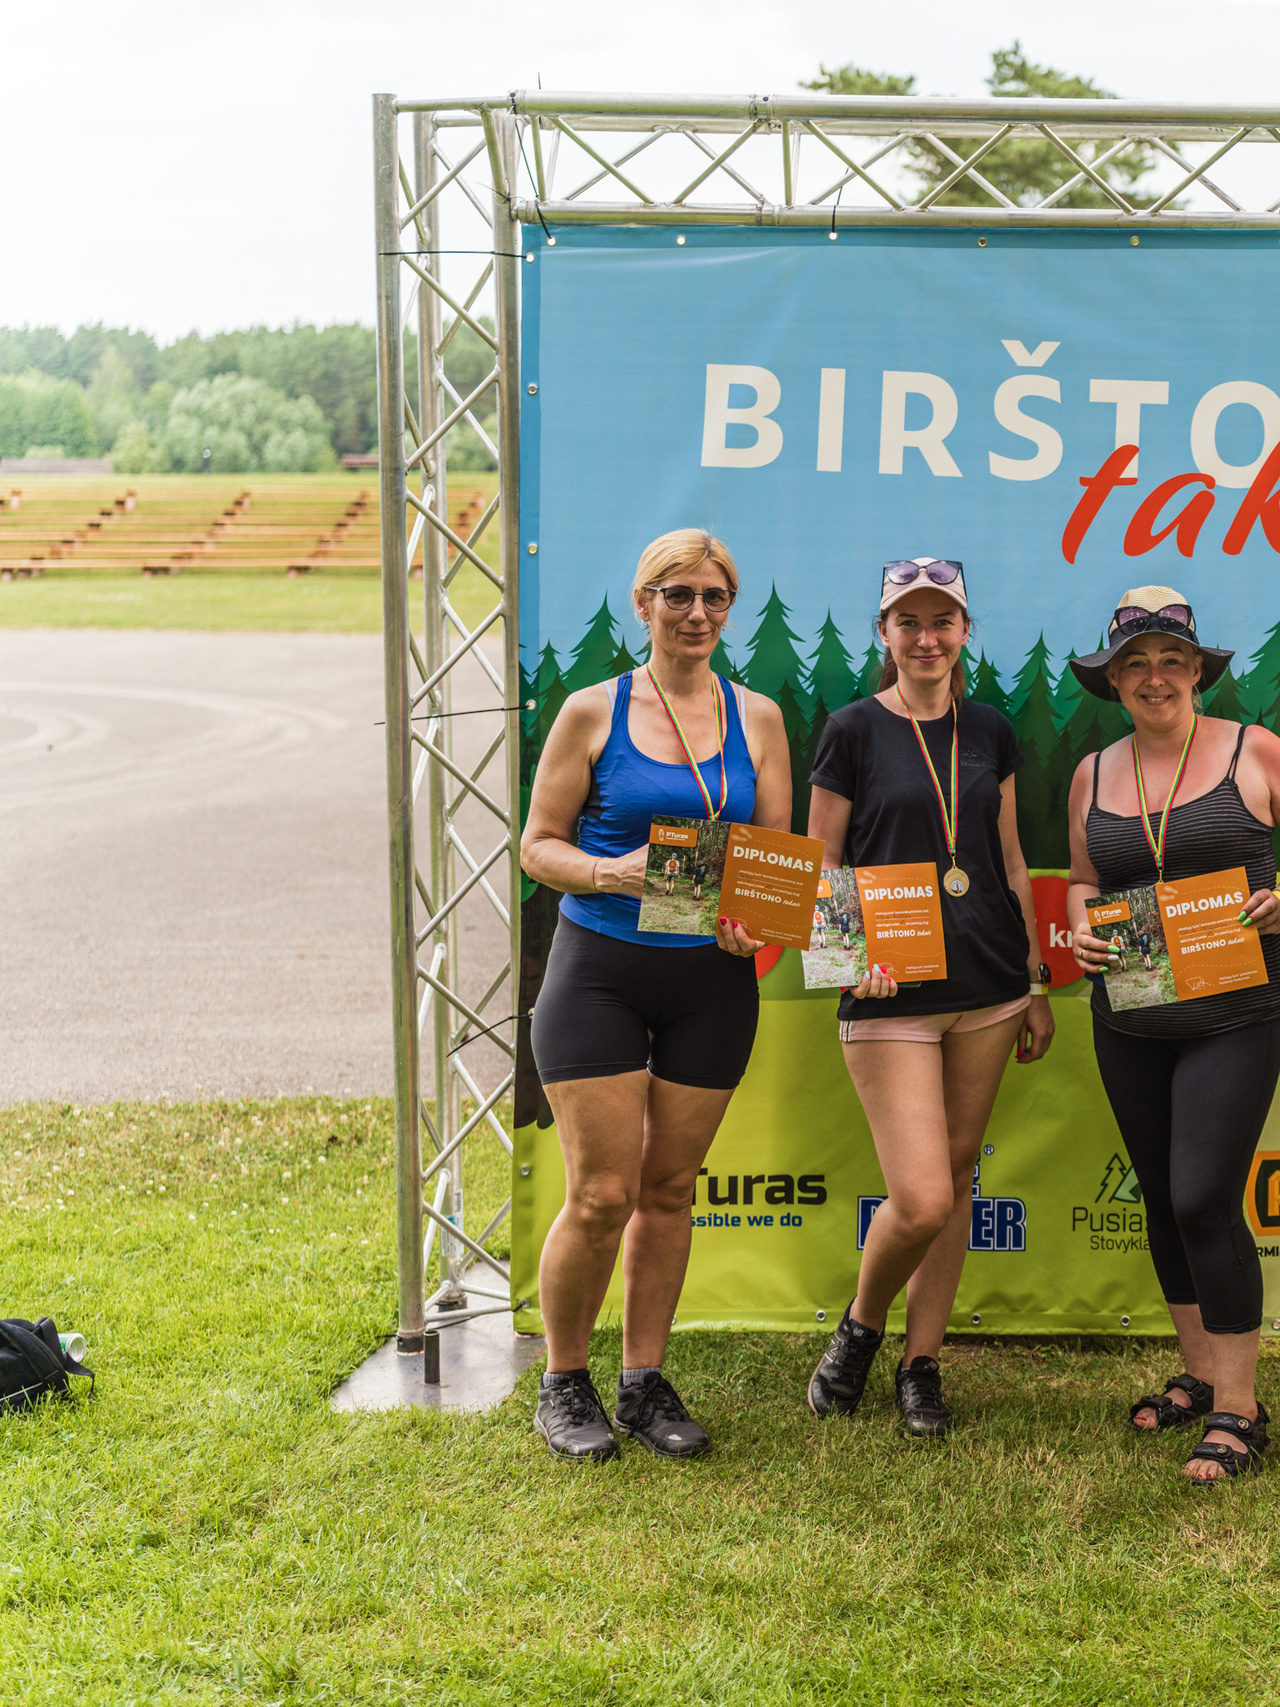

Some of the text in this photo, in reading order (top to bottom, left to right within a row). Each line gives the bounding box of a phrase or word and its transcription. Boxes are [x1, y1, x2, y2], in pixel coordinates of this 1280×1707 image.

[733, 845, 814, 873] DIPLOMAS
[735, 887, 782, 904] BIRŠTONO
[864, 885, 934, 901] DIPLOMAS
[1165, 891, 1244, 919] DIPLOMAS
[876, 929, 916, 939] BIRŠTONO
[1181, 939, 1227, 955] BIRŠTONO
[747, 1215, 774, 1227] we
[780, 1212, 803, 1227] do
[1072, 1206, 1147, 1233] Pusia
